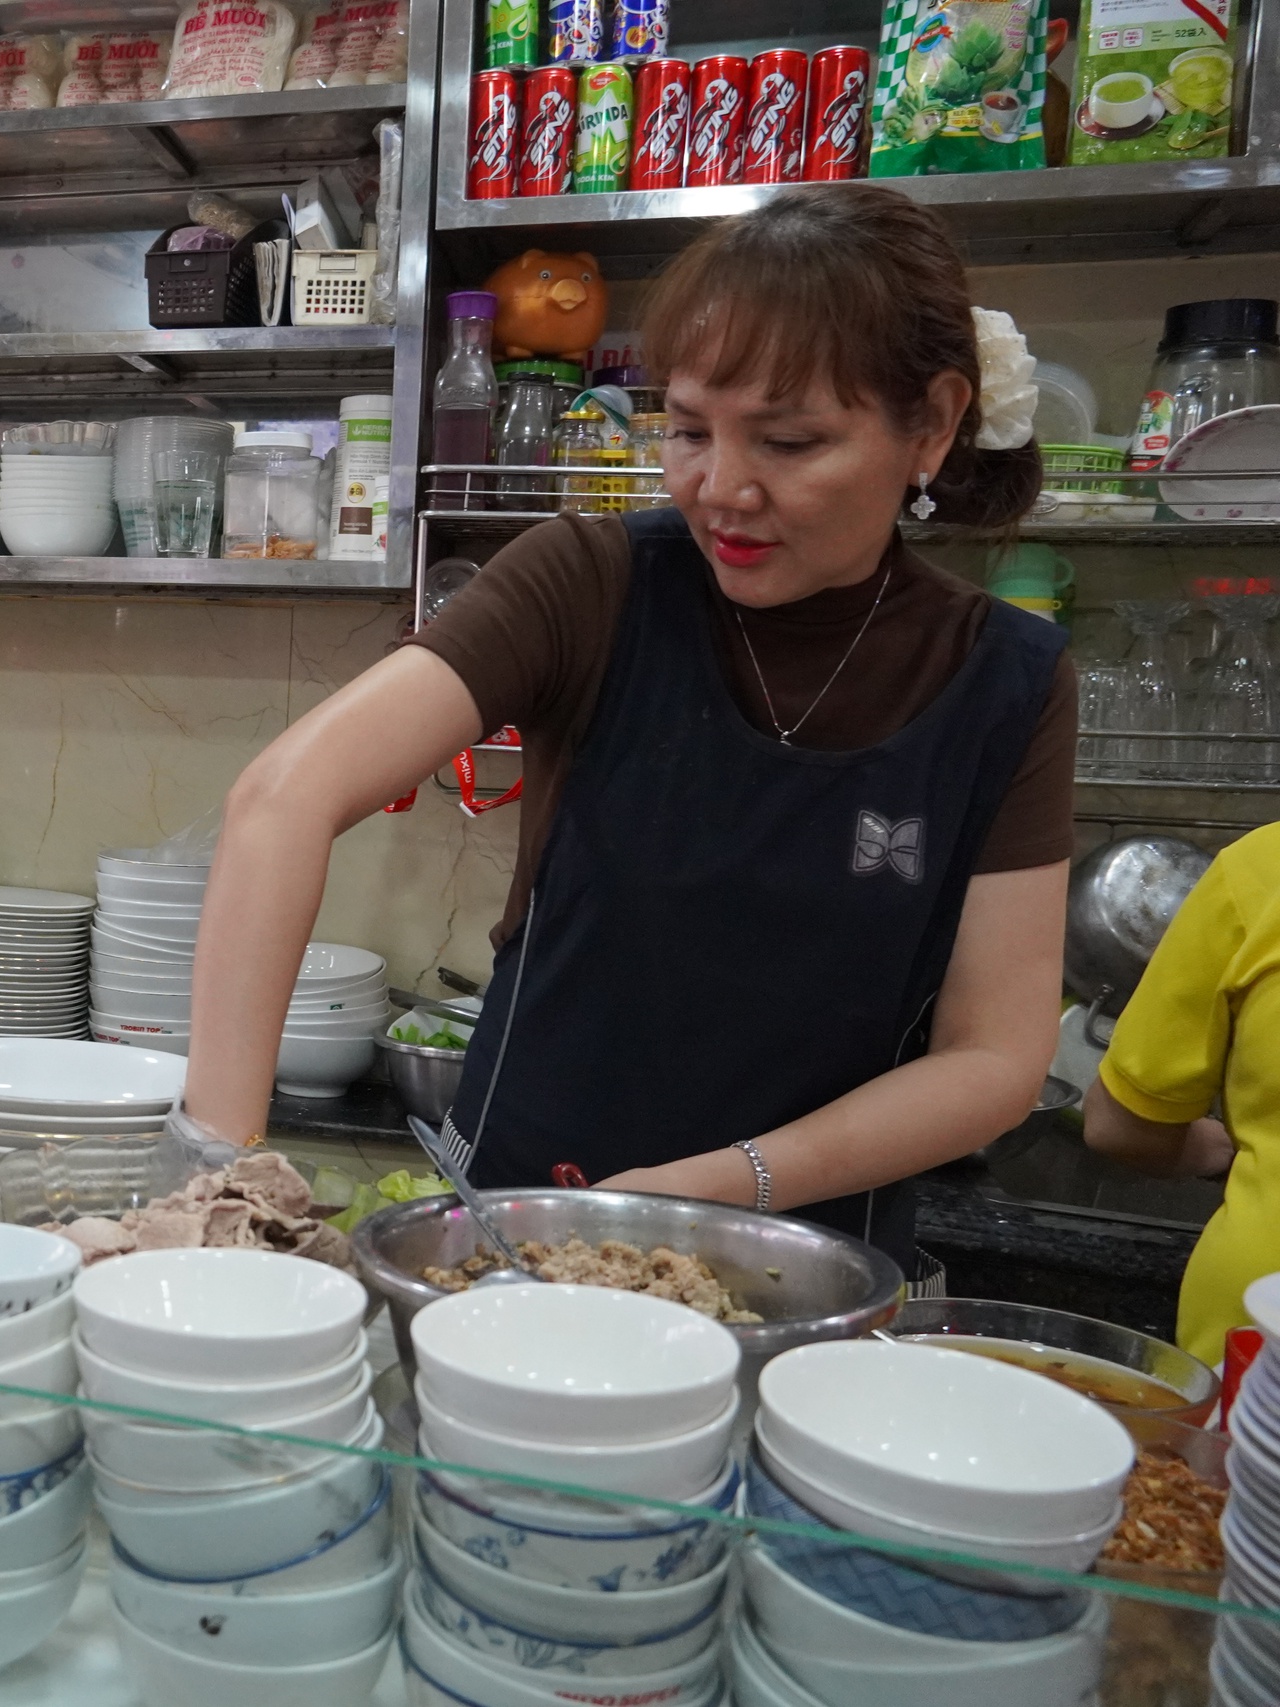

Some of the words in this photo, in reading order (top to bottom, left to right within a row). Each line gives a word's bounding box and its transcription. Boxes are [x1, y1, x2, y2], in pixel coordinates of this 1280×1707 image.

[483, 104, 516, 166] STING
[530, 99, 570, 166] STING
[652, 93, 688, 158] STING
[695, 87, 738, 157] STING
[751, 80, 795, 153] STING
